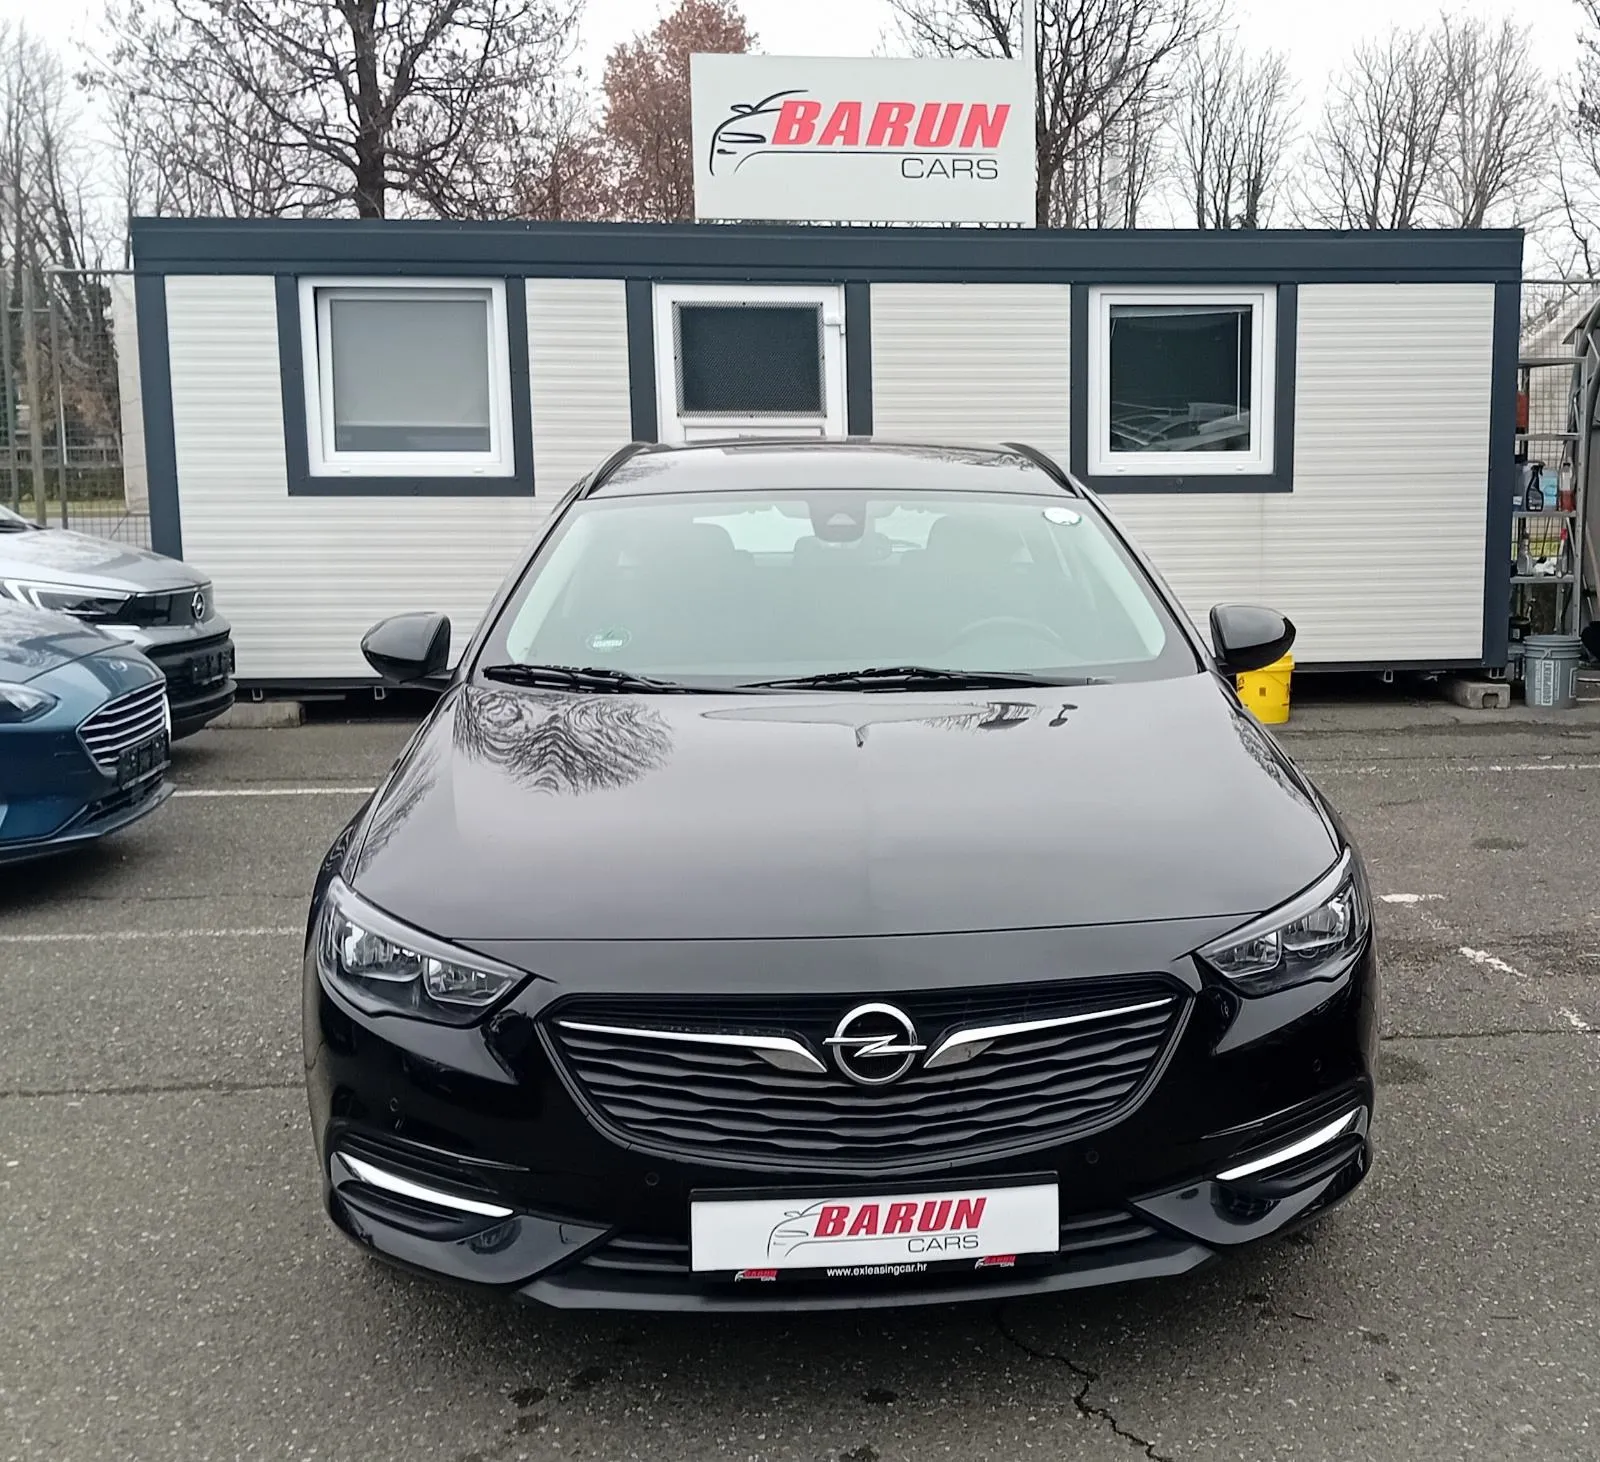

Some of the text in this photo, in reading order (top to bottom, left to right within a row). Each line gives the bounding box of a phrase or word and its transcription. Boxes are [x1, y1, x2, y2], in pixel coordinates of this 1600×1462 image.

[771, 100, 1011, 148] BARUN
[901, 158, 999, 180] CARS
[813, 1196, 987, 1238] BARUN
[907, 1234, 979, 1254] CARS
[826, 1262, 928, 1277] www.exleasingcar.hr
